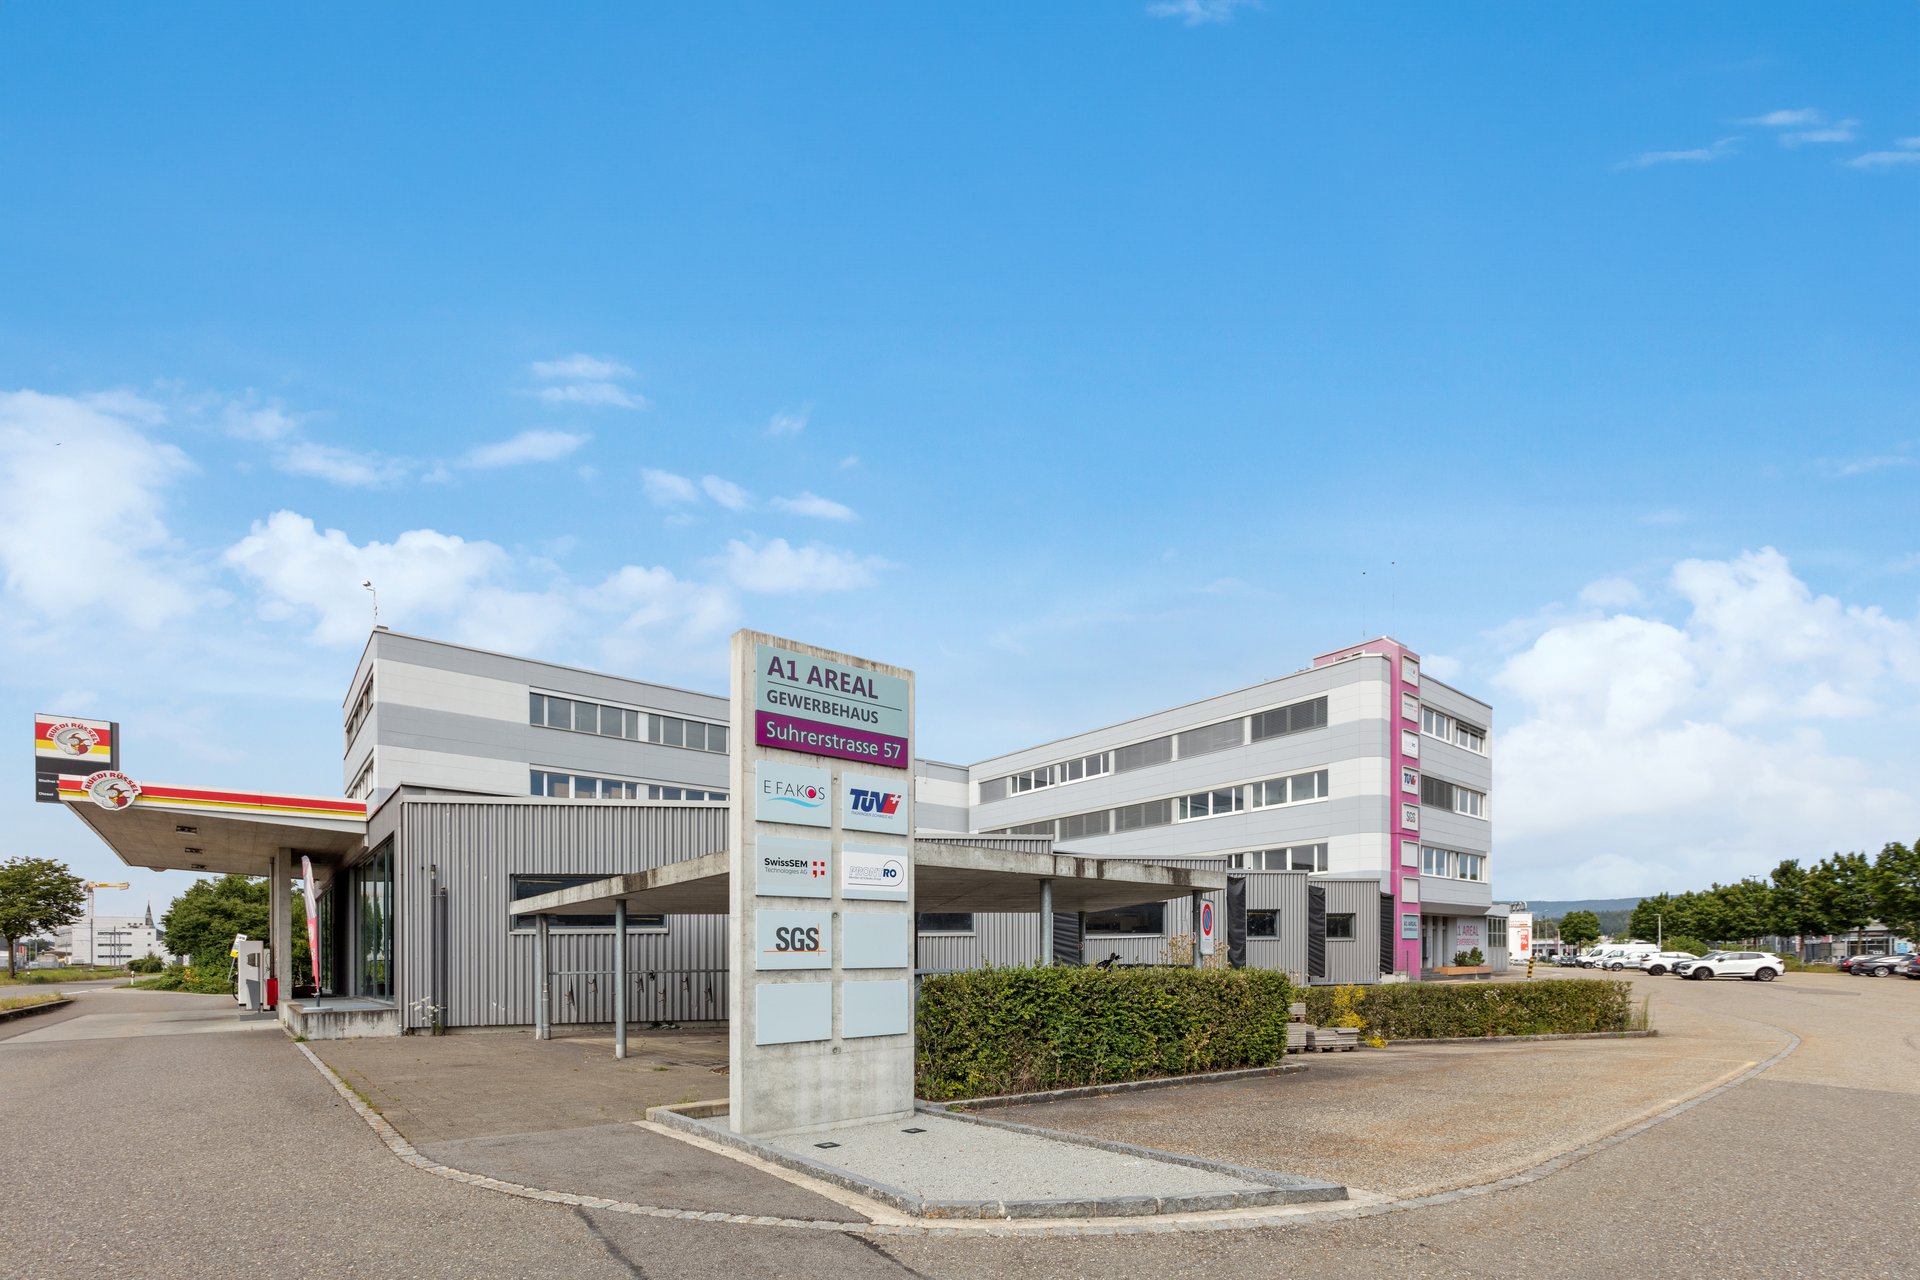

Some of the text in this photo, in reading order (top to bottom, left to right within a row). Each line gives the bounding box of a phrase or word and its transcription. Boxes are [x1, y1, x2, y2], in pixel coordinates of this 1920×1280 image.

[767, 656, 879, 700] A1 AREAL
[766, 689, 879, 724] GEWERBEHAUS
[48, 722, 99, 742] RUEDI RÜSSEL
[766, 721, 901, 759] Suhrerstrasse 57
[84, 772, 139, 793] RUEDI RÜSSEL
[850, 788, 889, 813] TÜV
[1406, 811, 1416, 823] SGS
[764, 857, 808, 868] SwissSEM
[764, 867, 800, 875] Technologies
[775, 926, 819, 952] SGS
